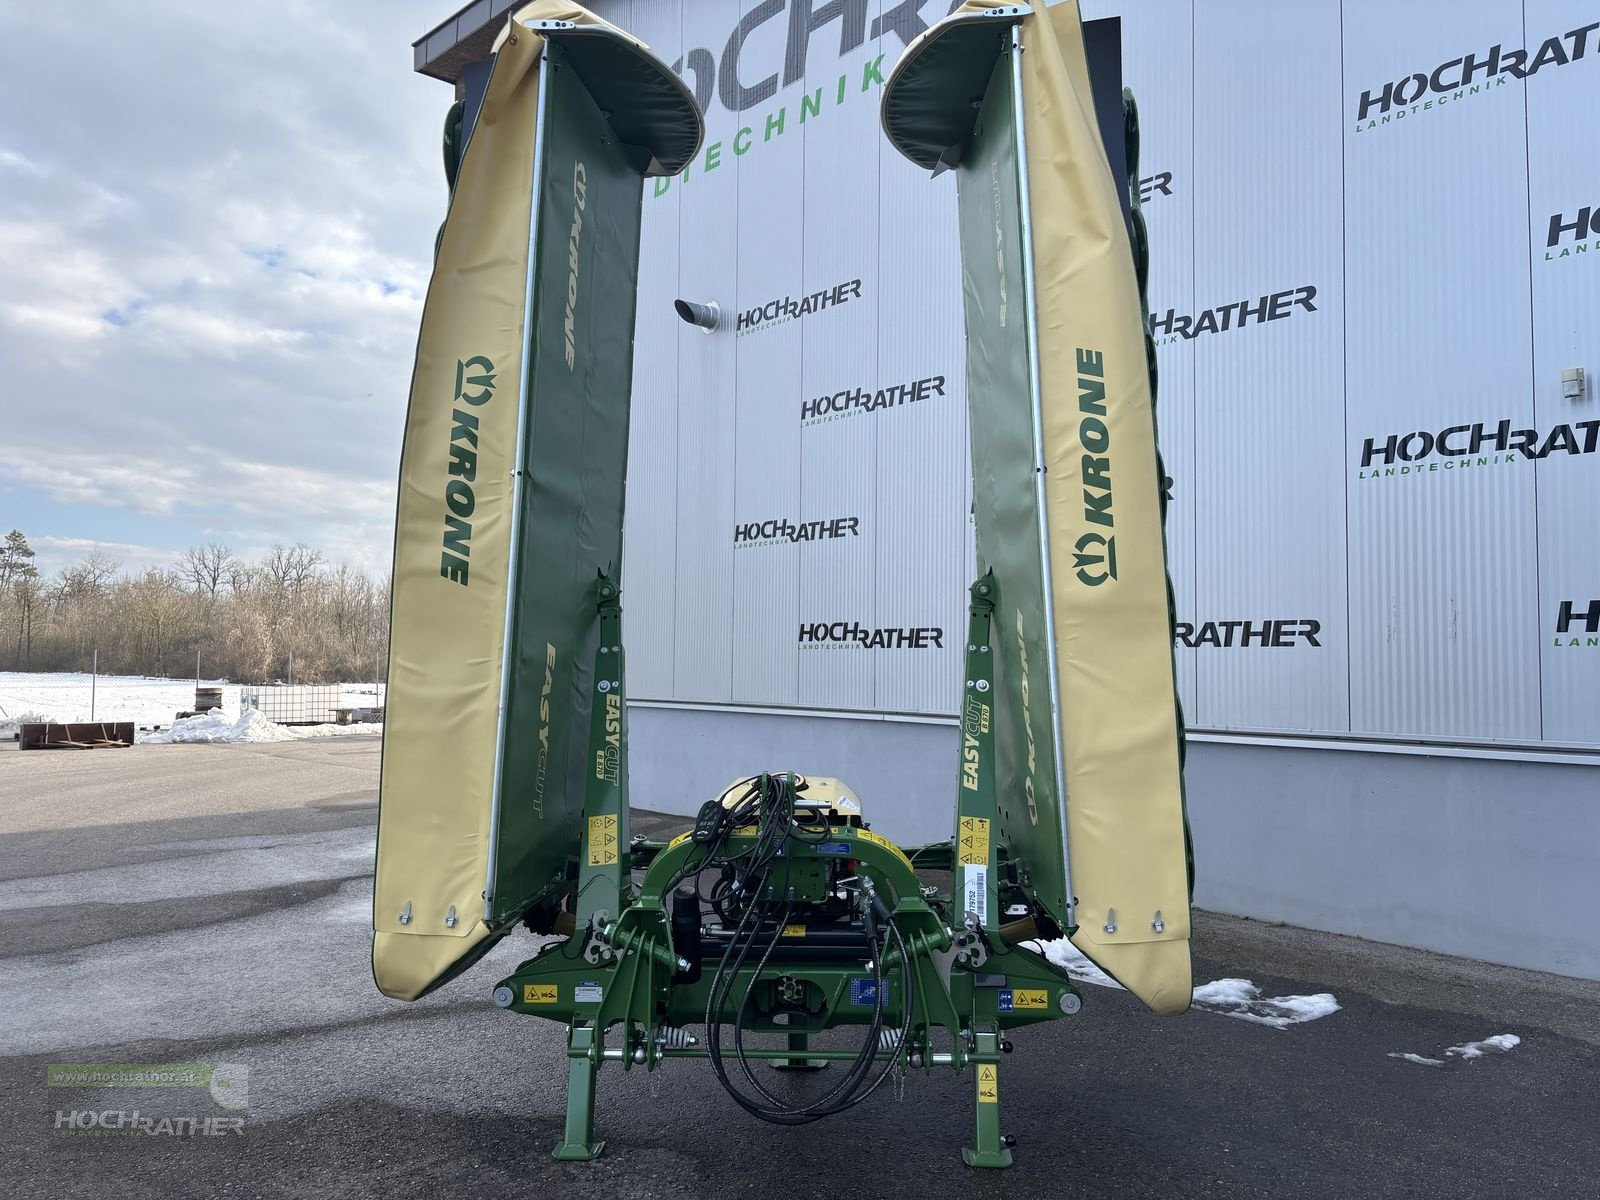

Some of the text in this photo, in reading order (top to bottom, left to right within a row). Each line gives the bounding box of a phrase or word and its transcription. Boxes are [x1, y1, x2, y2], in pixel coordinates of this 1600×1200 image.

[1357, 21, 1600, 121] HOCHRAT
[1355, 76, 1506, 133] LANDTECHNIK
[736, 278, 862, 332] HOCHRATHER
[736, 315, 792, 338] LANDTECHNIK
[800, 375, 946, 420] HOCHRATHER
[1076, 347, 1115, 528] KRONE
[1359, 453, 1516, 480] LANDTECHNIK
[440, 408, 480, 587] KRONE
[733, 539, 789, 550] LANDTECHNIK
[734, 516, 860, 543] HOCHRATHER
[798, 621, 944, 649] HOCHRATHER
[798, 643, 861, 651] LANDTECHNIK
[603, 693, 621, 787] EASYCUT
[962, 694, 982, 792] EASYCUT
